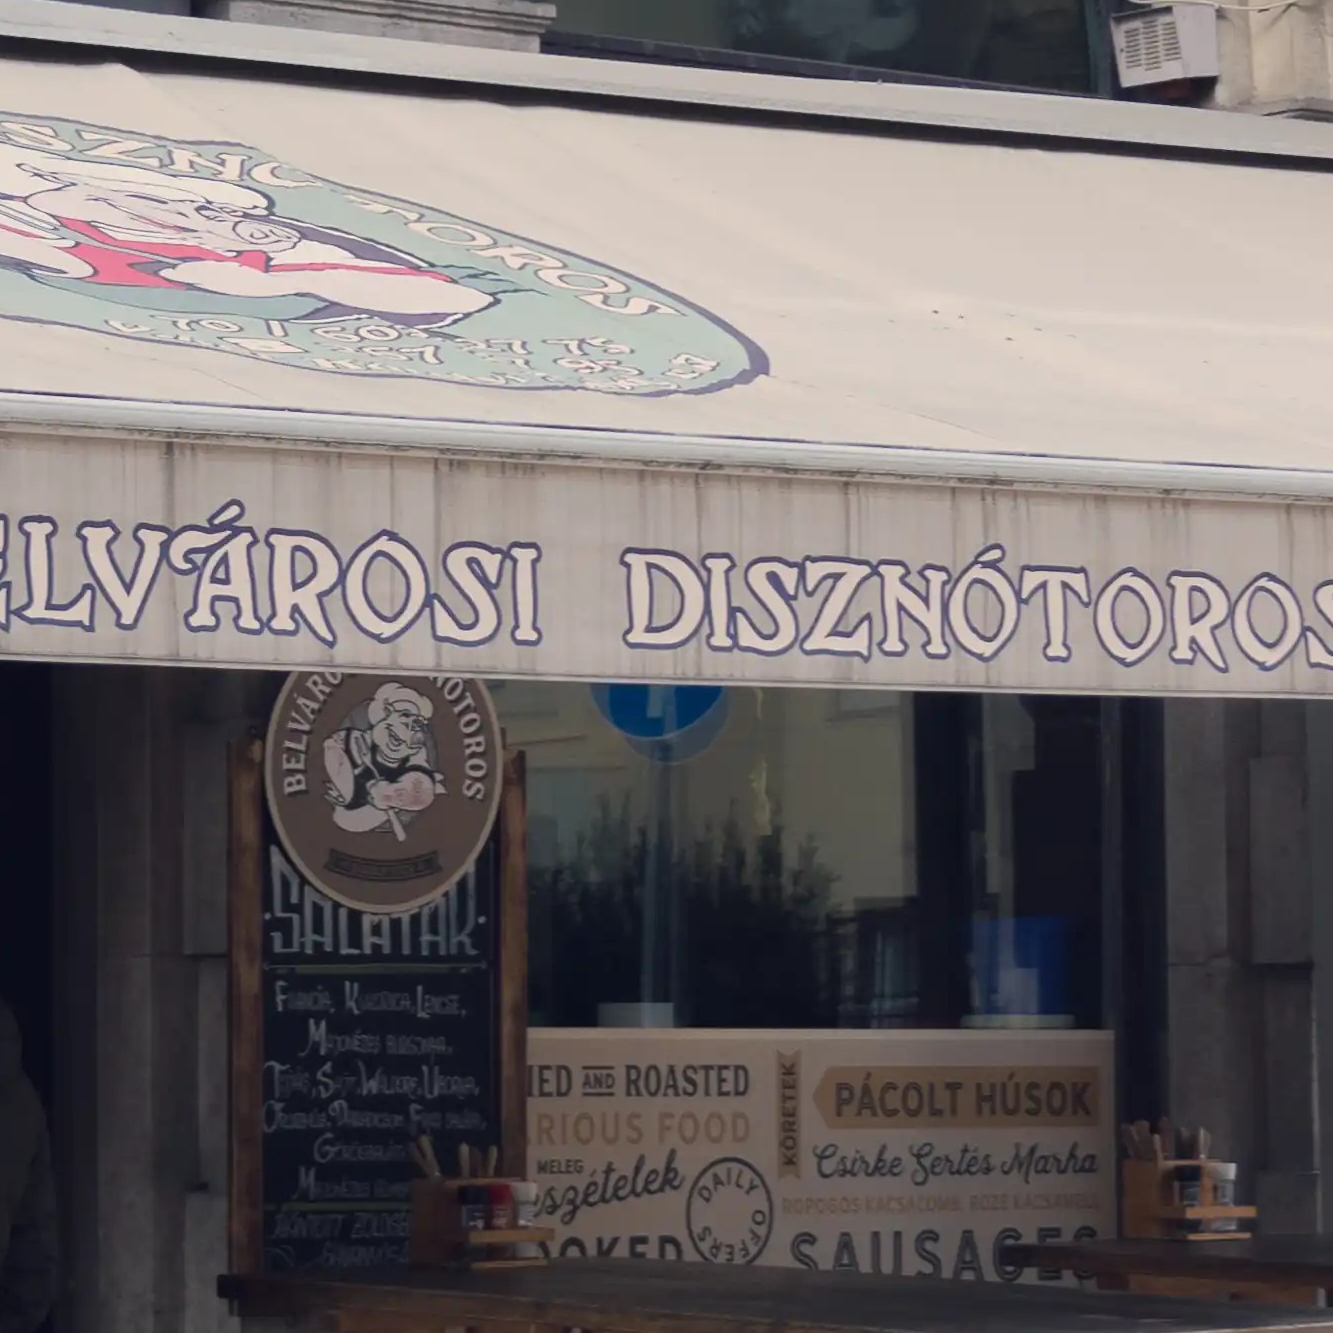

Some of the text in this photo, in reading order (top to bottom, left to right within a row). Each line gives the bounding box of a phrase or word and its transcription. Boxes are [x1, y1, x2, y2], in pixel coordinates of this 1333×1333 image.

[582, 1071, 616, 1091] AND
[625, 1064, 750, 1098] ROASTED
[833, 1071, 1094, 1118] PÁCOLT HÚSOK
[528, 1110, 644, 1146] RIOUS
[657, 1110, 751, 1145] FOOD
[779, 1060, 798, 1167] KÖRETEK
[534, 1147, 686, 1225] szételek
[536, 1158, 585, 1175] MELEG
[696, 1166, 760, 1204] DAILY
[812, 1140, 1099, 1186] Csirke Sertés Marha
[696, 1209, 767, 1262] OFFERS
